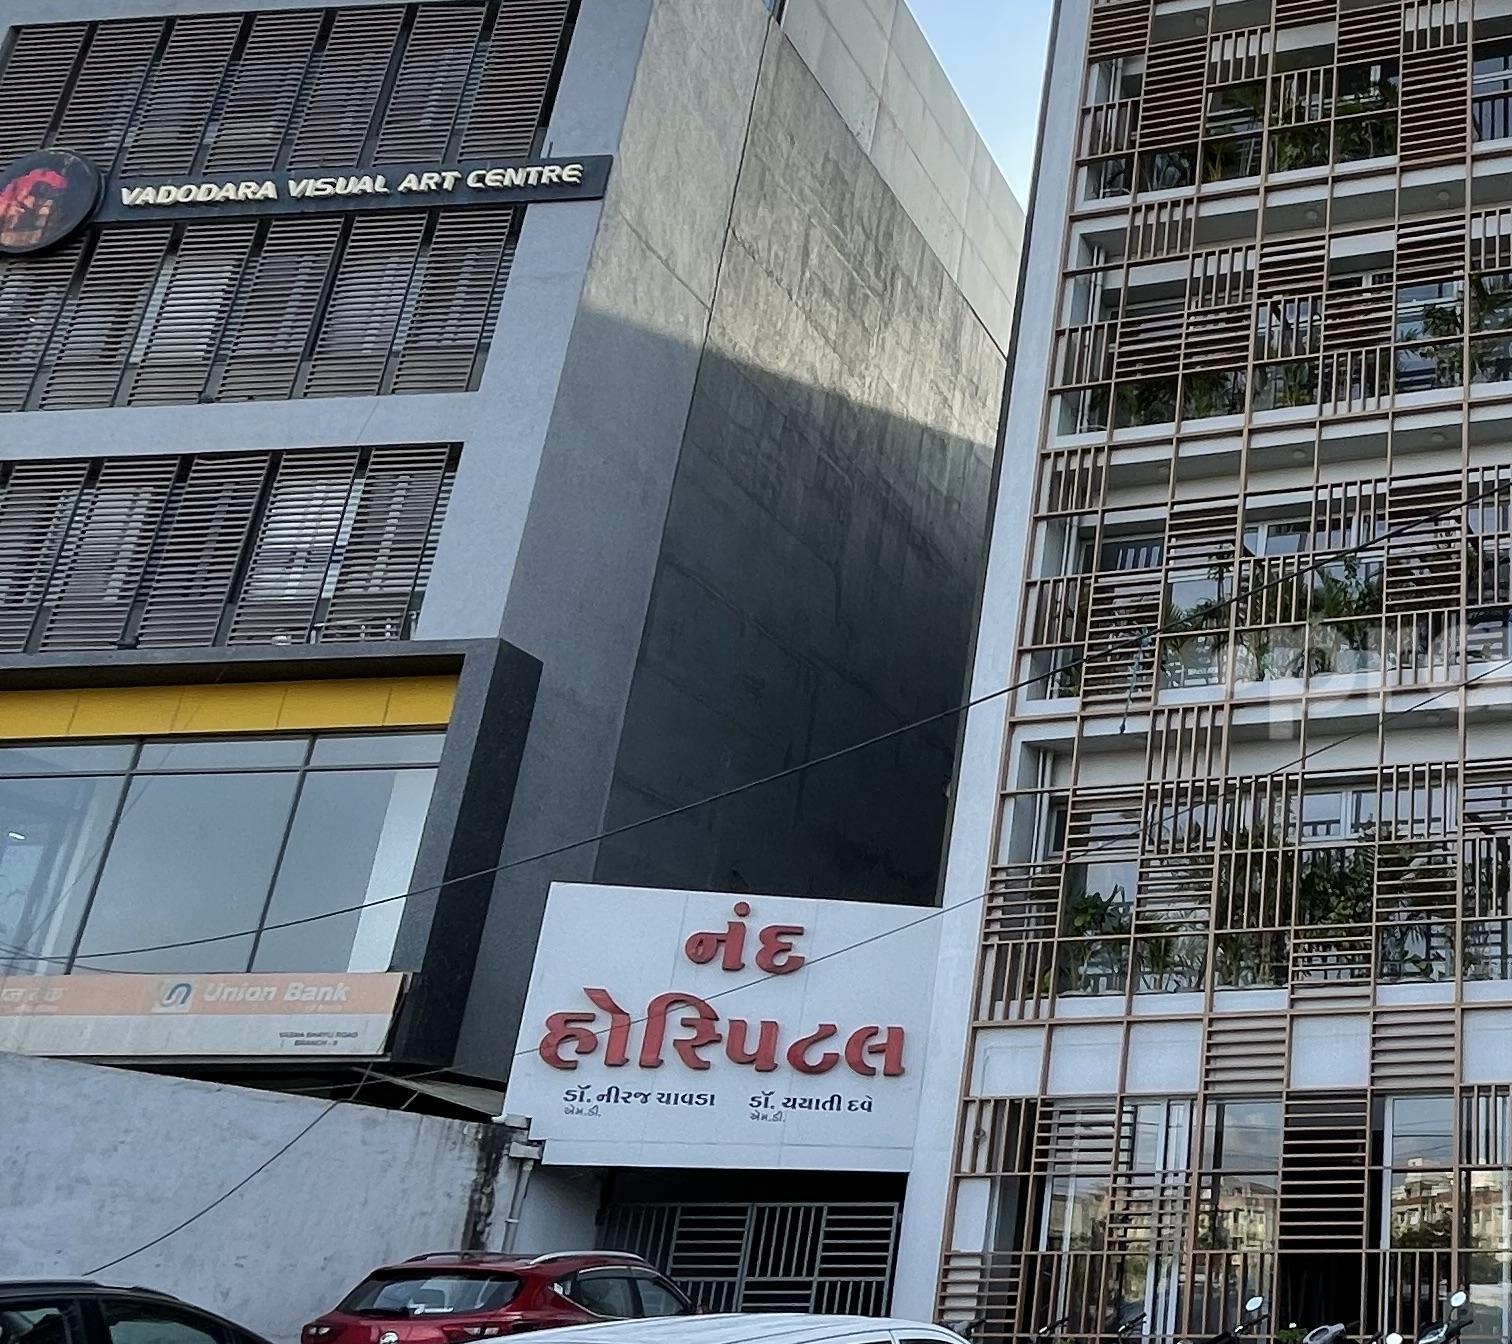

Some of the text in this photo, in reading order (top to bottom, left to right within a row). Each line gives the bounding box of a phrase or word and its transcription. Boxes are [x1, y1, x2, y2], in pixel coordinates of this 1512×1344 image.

[120, 163, 585, 206] VADODARA VISUAL ART CENTRE
[684, 901, 806, 975] નંદ
[203, 981, 351, 1002] Union Bank
[538, 987, 906, 1077] હોસ્પિટલ
